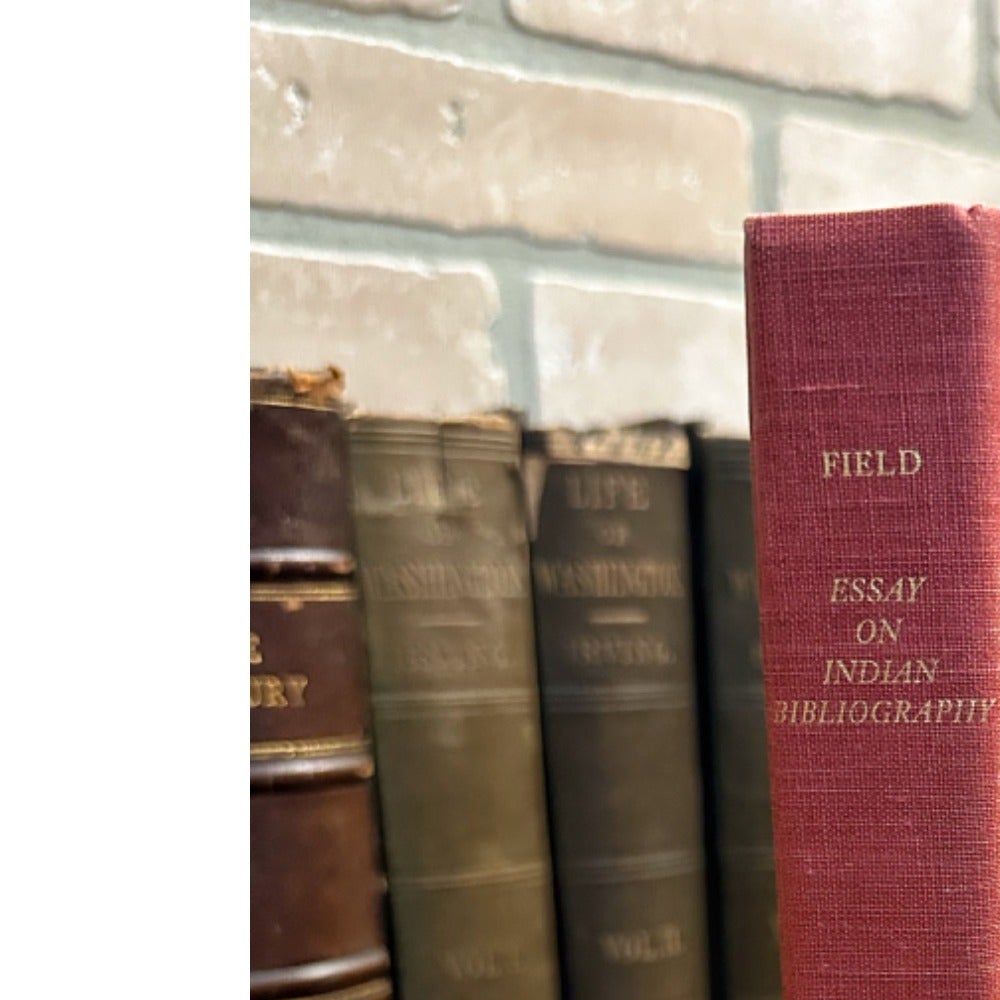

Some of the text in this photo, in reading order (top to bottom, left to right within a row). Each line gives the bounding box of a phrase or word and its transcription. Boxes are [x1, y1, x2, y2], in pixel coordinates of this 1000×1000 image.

[822, 448, 924, 478] FIELD
[830, 575, 927, 603] ESSAY
[855, 617, 904, 645] ON
[822, 658, 940, 686] INDIAN
[772, 697, 998, 725] BIBLIOGRAPHY
